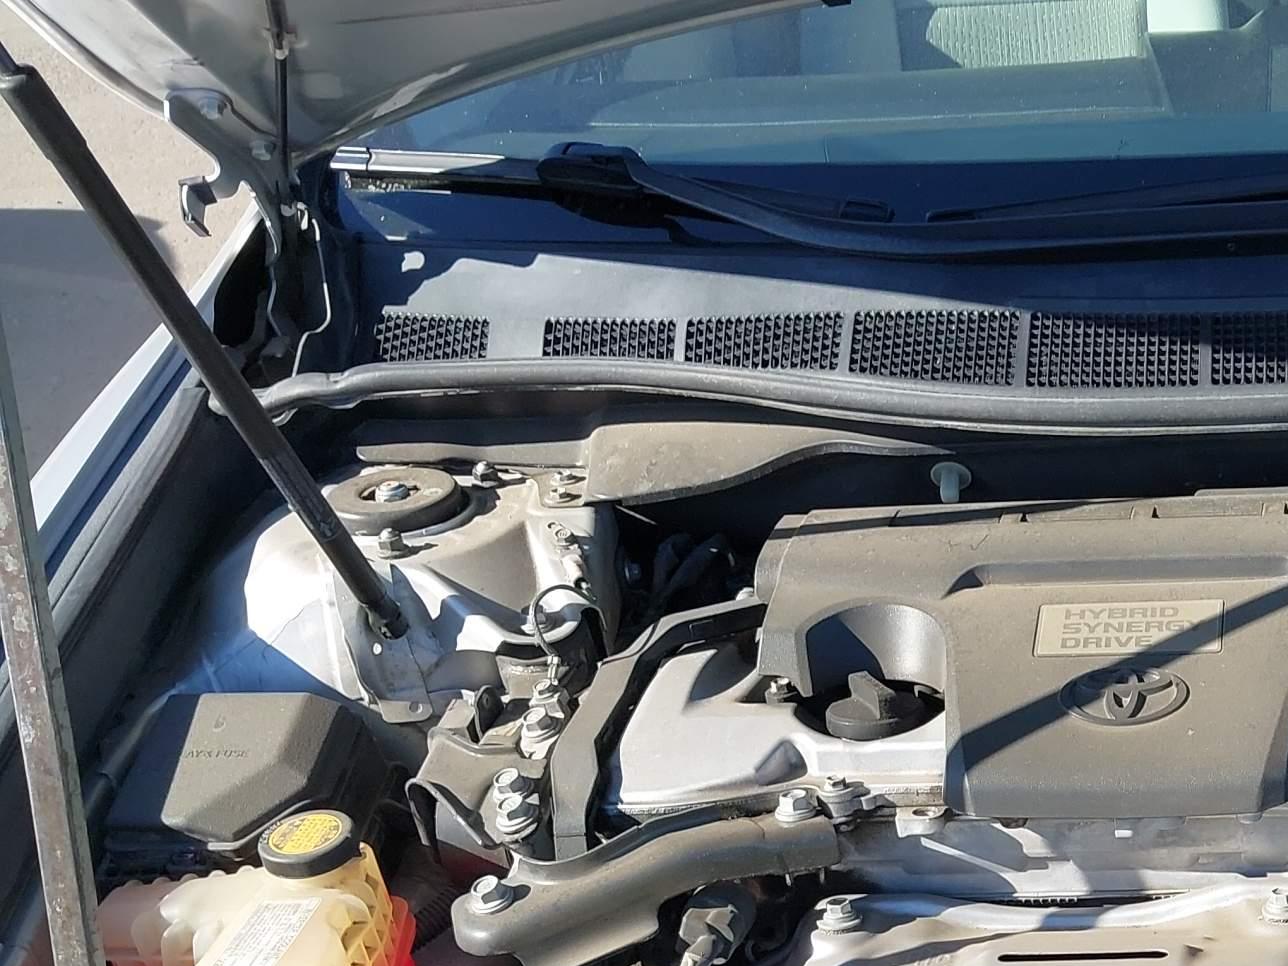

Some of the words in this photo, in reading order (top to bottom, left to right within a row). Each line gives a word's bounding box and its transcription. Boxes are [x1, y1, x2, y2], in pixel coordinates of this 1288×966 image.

[1064, 606, 1180, 620] HYBRID
[1062, 619, 1198, 634] SYNERGY
[1060, 634, 1153, 649] DRIVE
